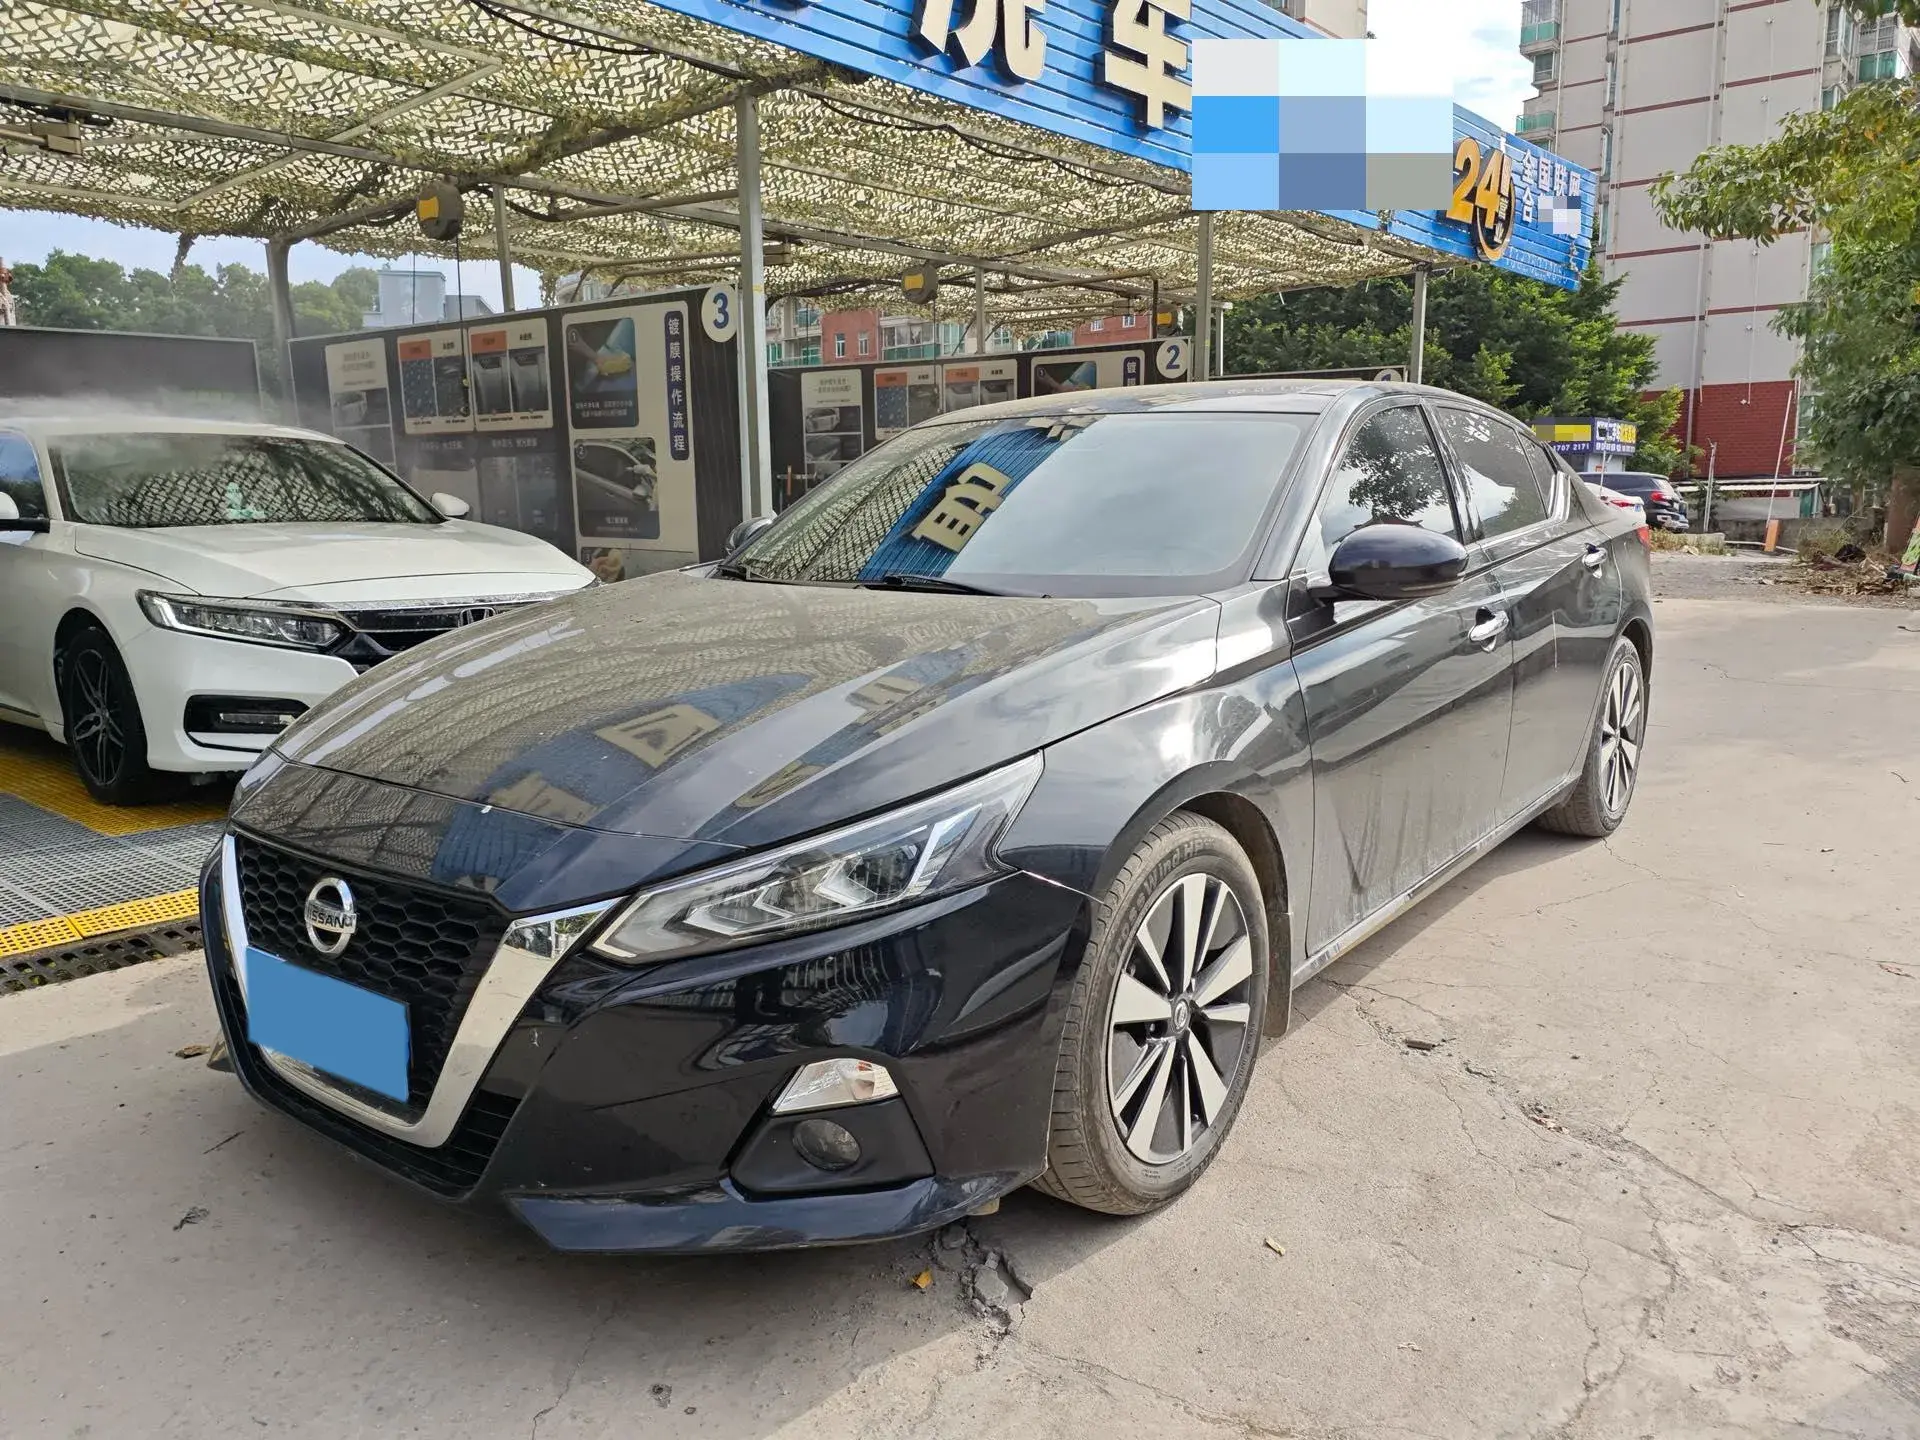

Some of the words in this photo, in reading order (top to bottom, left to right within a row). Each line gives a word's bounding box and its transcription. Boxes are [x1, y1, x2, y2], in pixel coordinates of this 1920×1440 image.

[1446, 136, 1503, 229] 24
[713, 292, 729, 329] 3
[1165, 344, 1181, 370] 2
[667, 317, 687, 452] 镀膜操作流程
[1573, 443, 1590, 451] 2171
